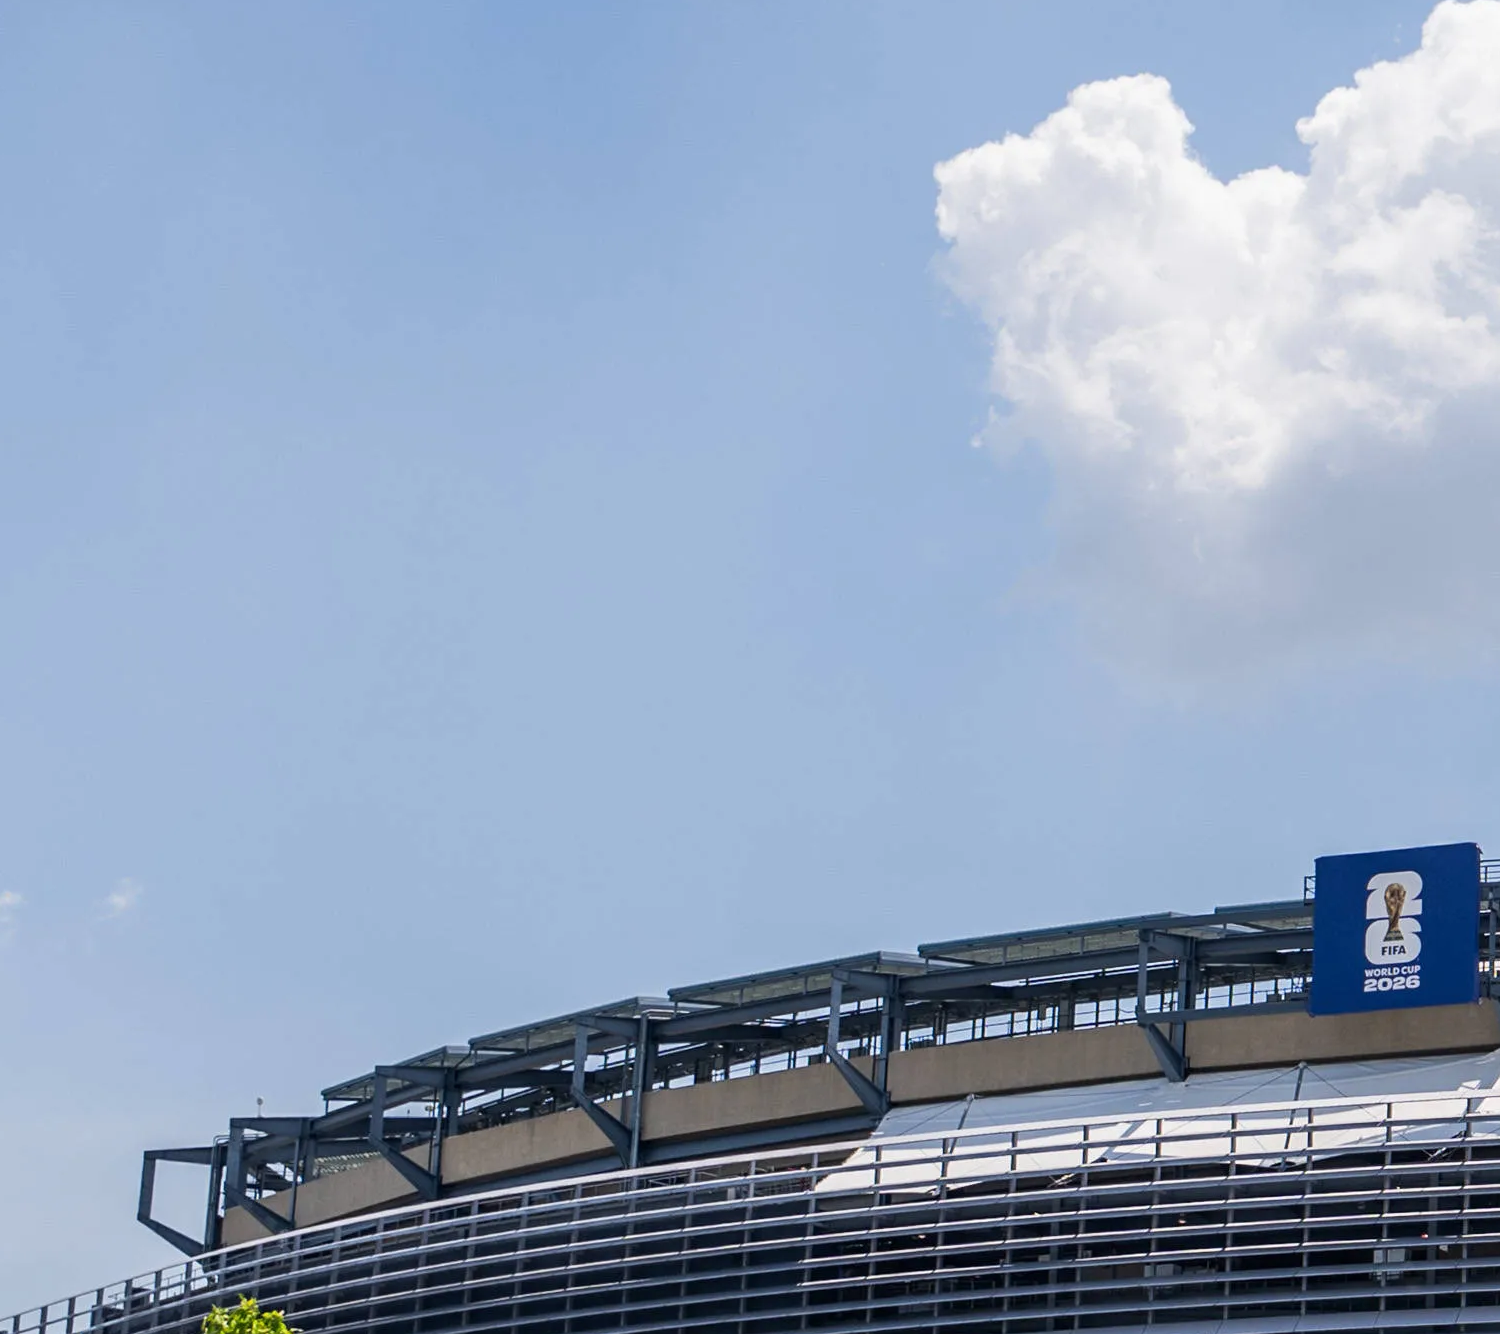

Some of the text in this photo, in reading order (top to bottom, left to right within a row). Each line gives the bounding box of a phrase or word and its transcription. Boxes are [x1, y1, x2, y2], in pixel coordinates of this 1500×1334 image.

[1381, 945, 1406, 956] FIFA
[1364, 965, 1421, 977] WORLD CUP
[1363, 975, 1421, 992] 2026
